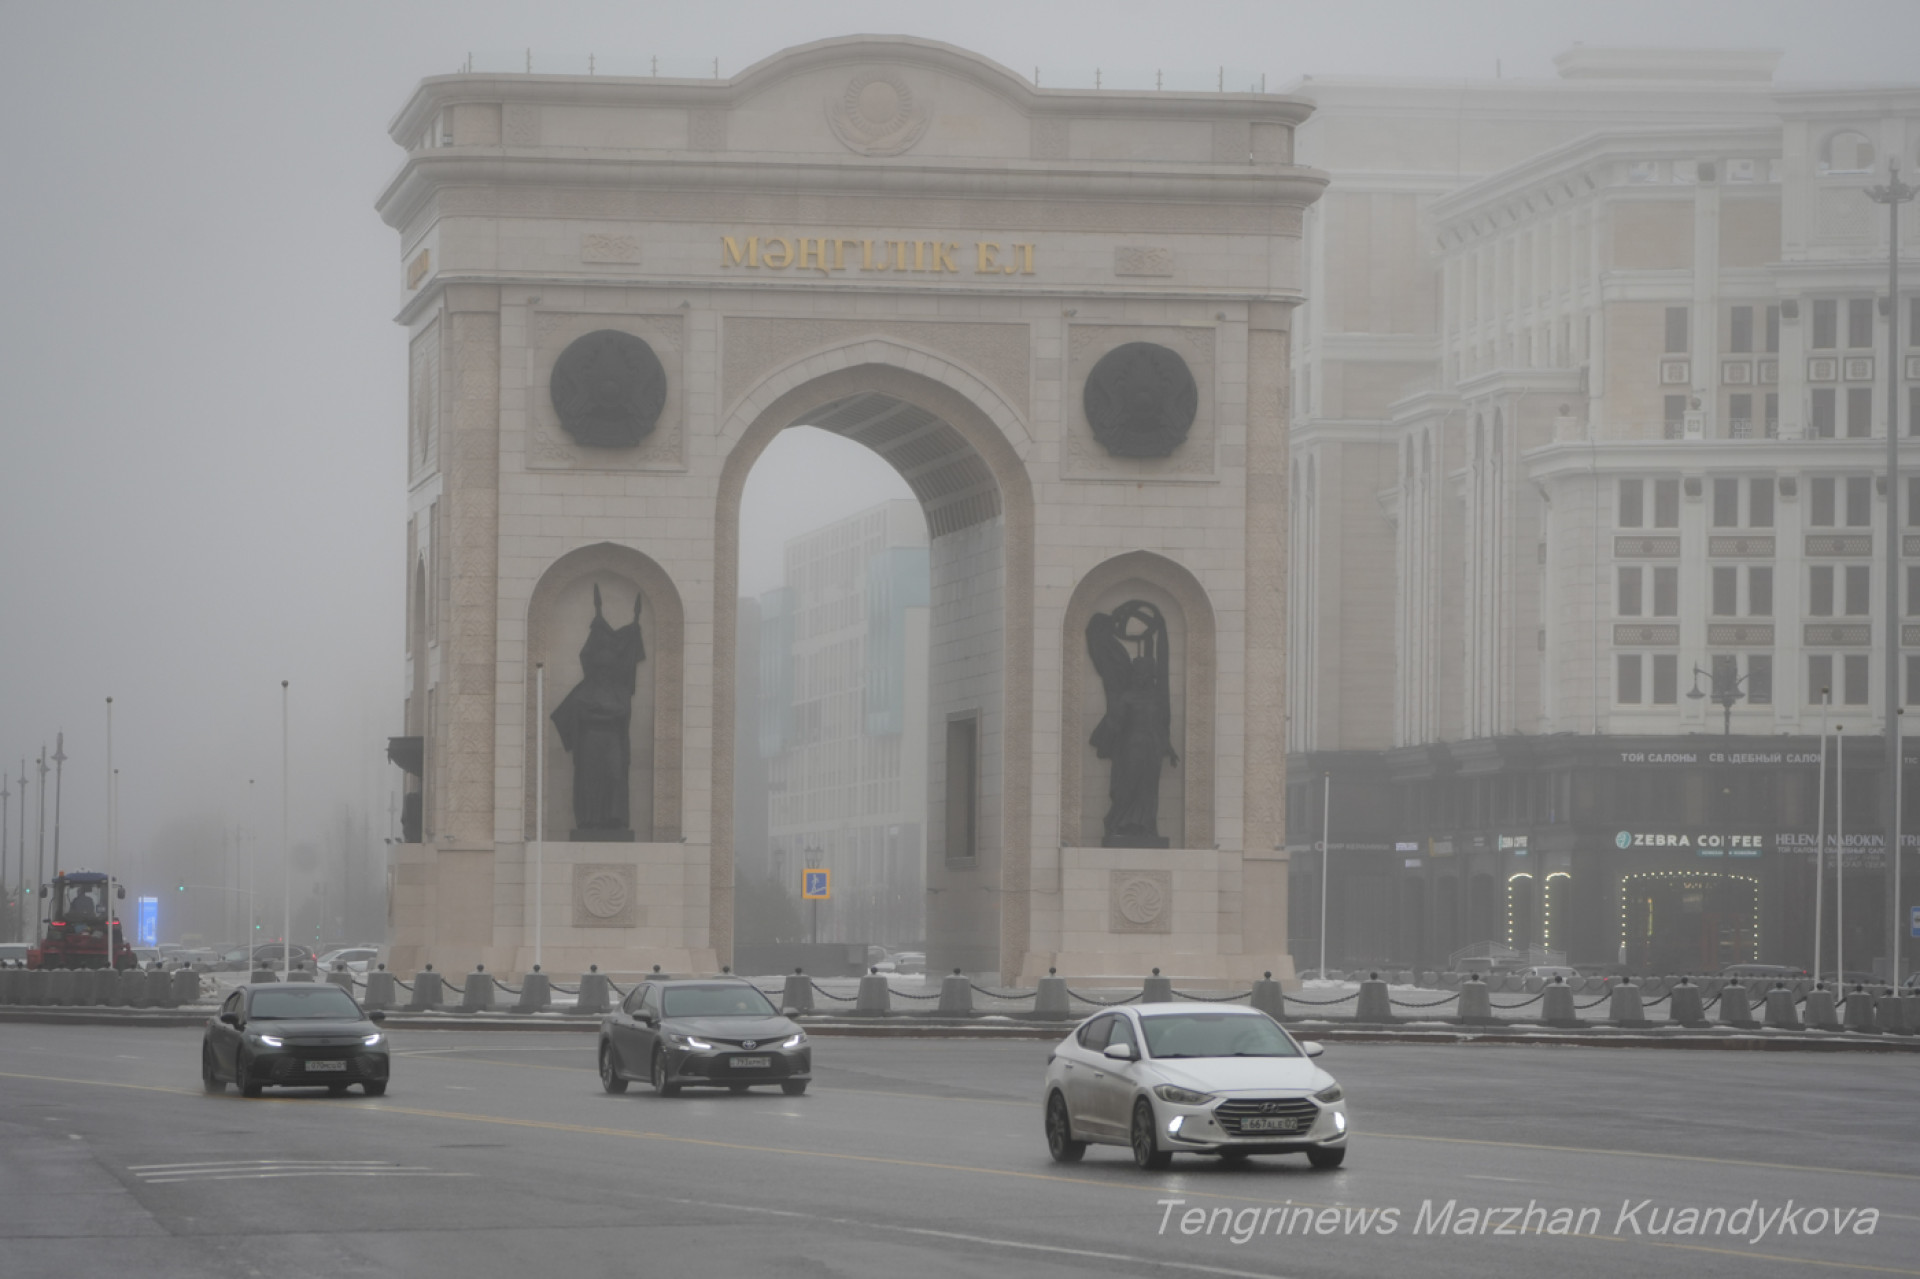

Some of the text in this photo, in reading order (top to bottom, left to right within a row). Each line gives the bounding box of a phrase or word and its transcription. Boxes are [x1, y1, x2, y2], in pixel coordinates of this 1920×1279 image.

[720, 235, 1036, 278] МӘҢГІЛІК ЕЛ
[1621, 752, 1645, 764] ТОЙ
[1648, 753, 1697, 765] САЛОНЫ
[1634, 834, 1690, 847] ZEBRA
